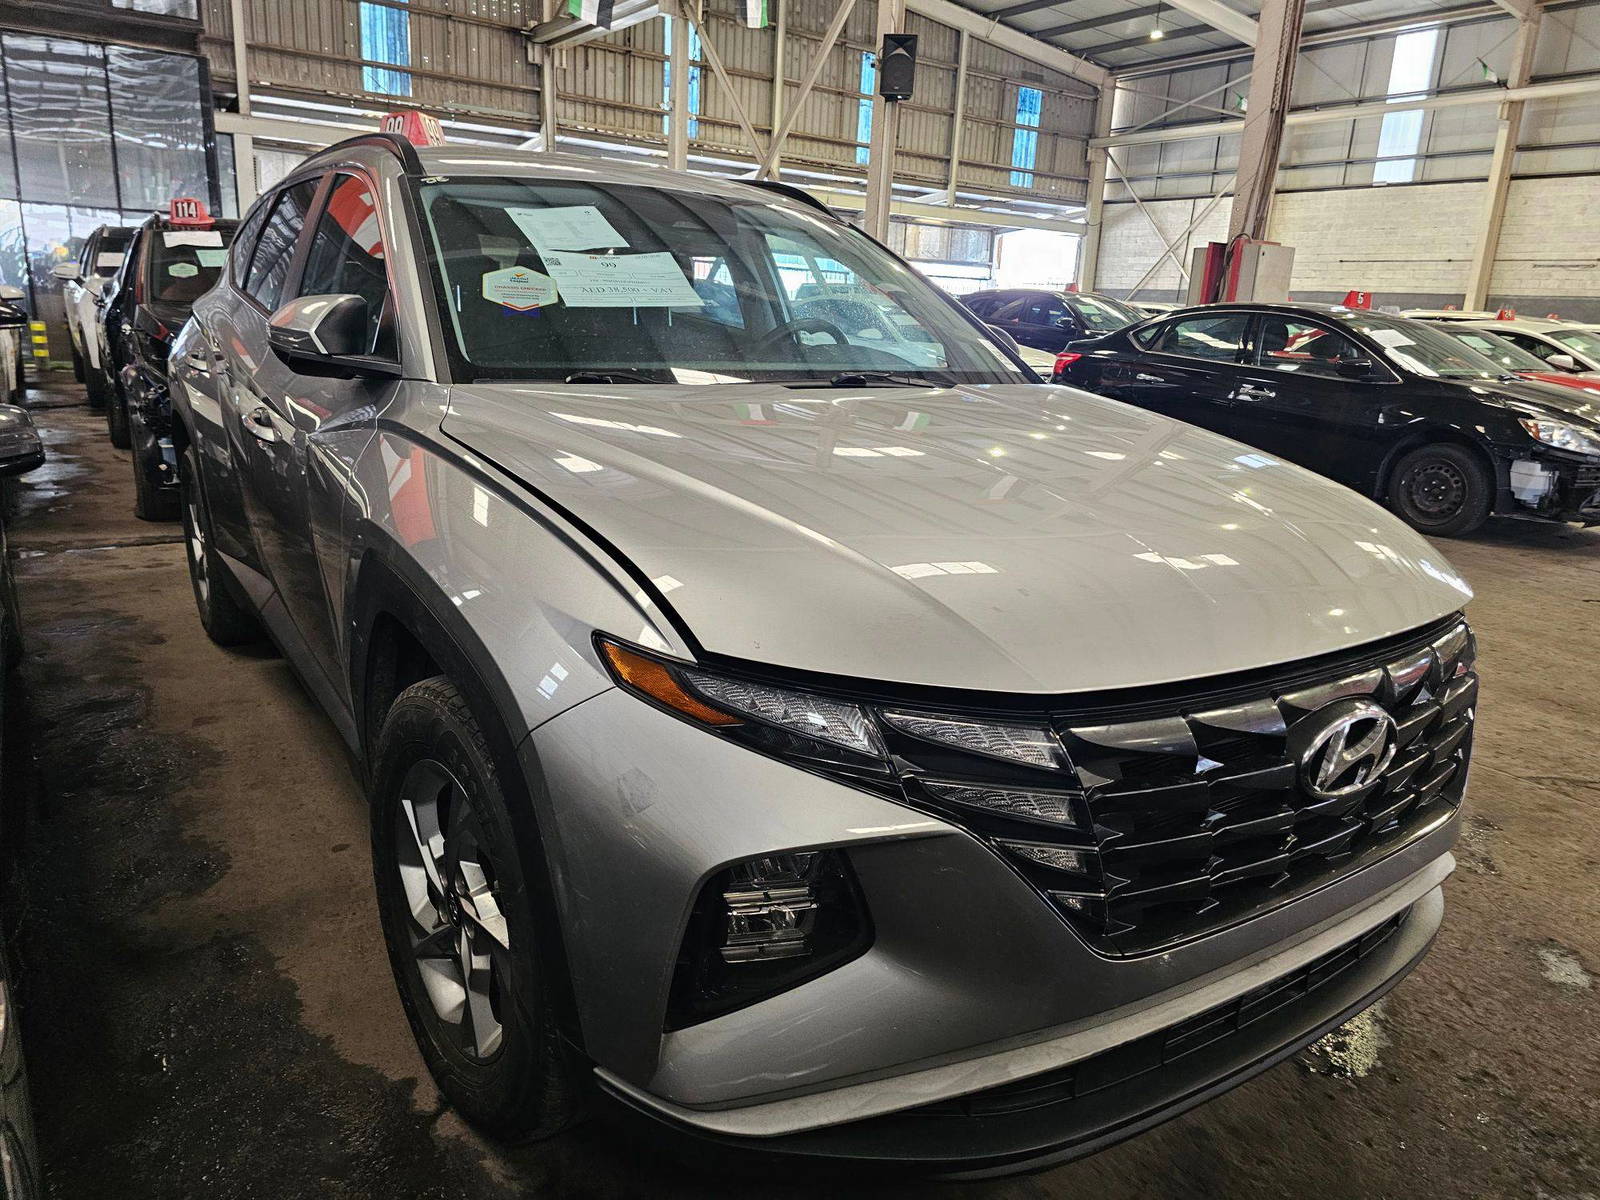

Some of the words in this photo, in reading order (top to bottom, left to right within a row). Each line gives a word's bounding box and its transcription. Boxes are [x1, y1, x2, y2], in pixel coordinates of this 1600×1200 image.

[176, 202, 196, 217] 114
[581, 286, 606, 294] AED
[650, 287, 673, 295] VAT
[1357, 292, 1364, 305] 5
